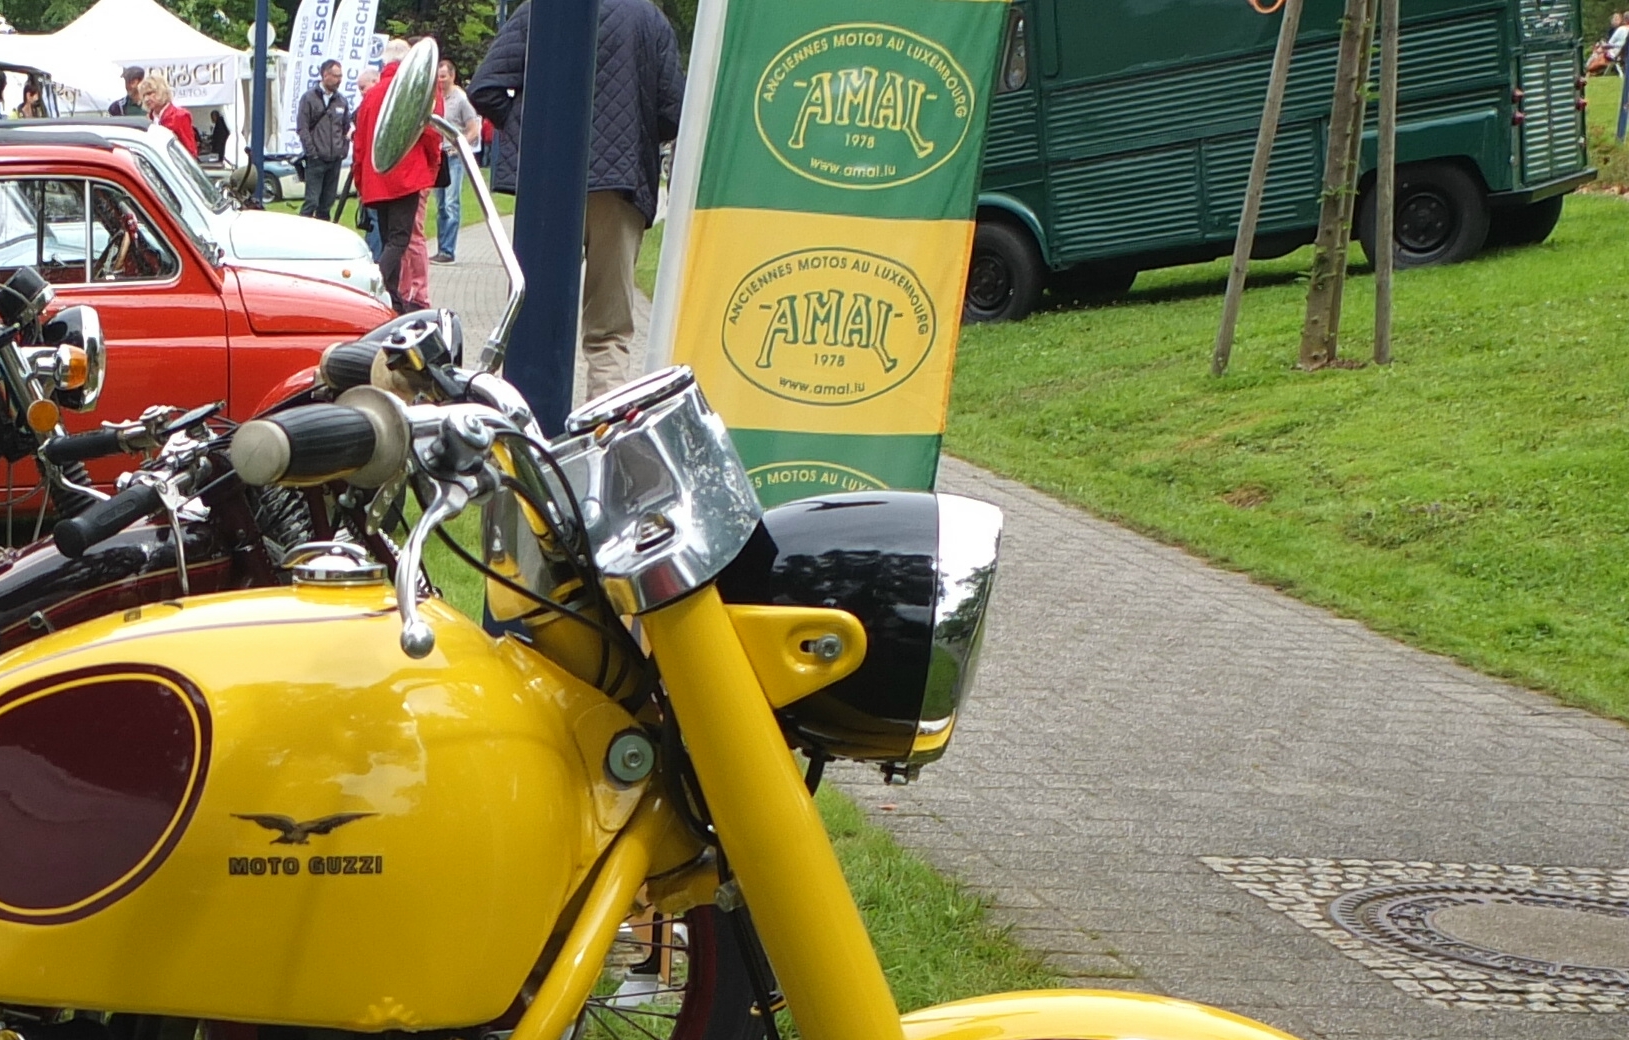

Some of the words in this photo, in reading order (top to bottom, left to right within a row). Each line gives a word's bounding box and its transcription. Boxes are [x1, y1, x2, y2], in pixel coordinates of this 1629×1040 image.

[311, 0, 330, 56] PESC
[350, 0, 370, 60] PESCH
[763, 38, 829, 102] ANCIENNES
[833, 33, 883, 48] MOTOS
[886, 37, 905, 52] AU
[907, 44, 969, 118] LUXEMBOURG
[845, 134, 875, 149] 1978
[810, 157, 896, 178] www.amal.lu
[729, 263, 792, 325] ANCIENNES
[798, 256, 847, 271] MOTOS
[852, 259, 870, 273] AU
[874, 265, 929, 335] LUXEMOURG
[814, 354, 845, 367] 1978
[779, 377, 865, 394] www.amal.lu
[767, 470, 816, 485] MOTOS
[820, 472, 838, 484] AU
[228, 857, 300, 875] MOTO
[308, 855, 383, 875] GUZZI
